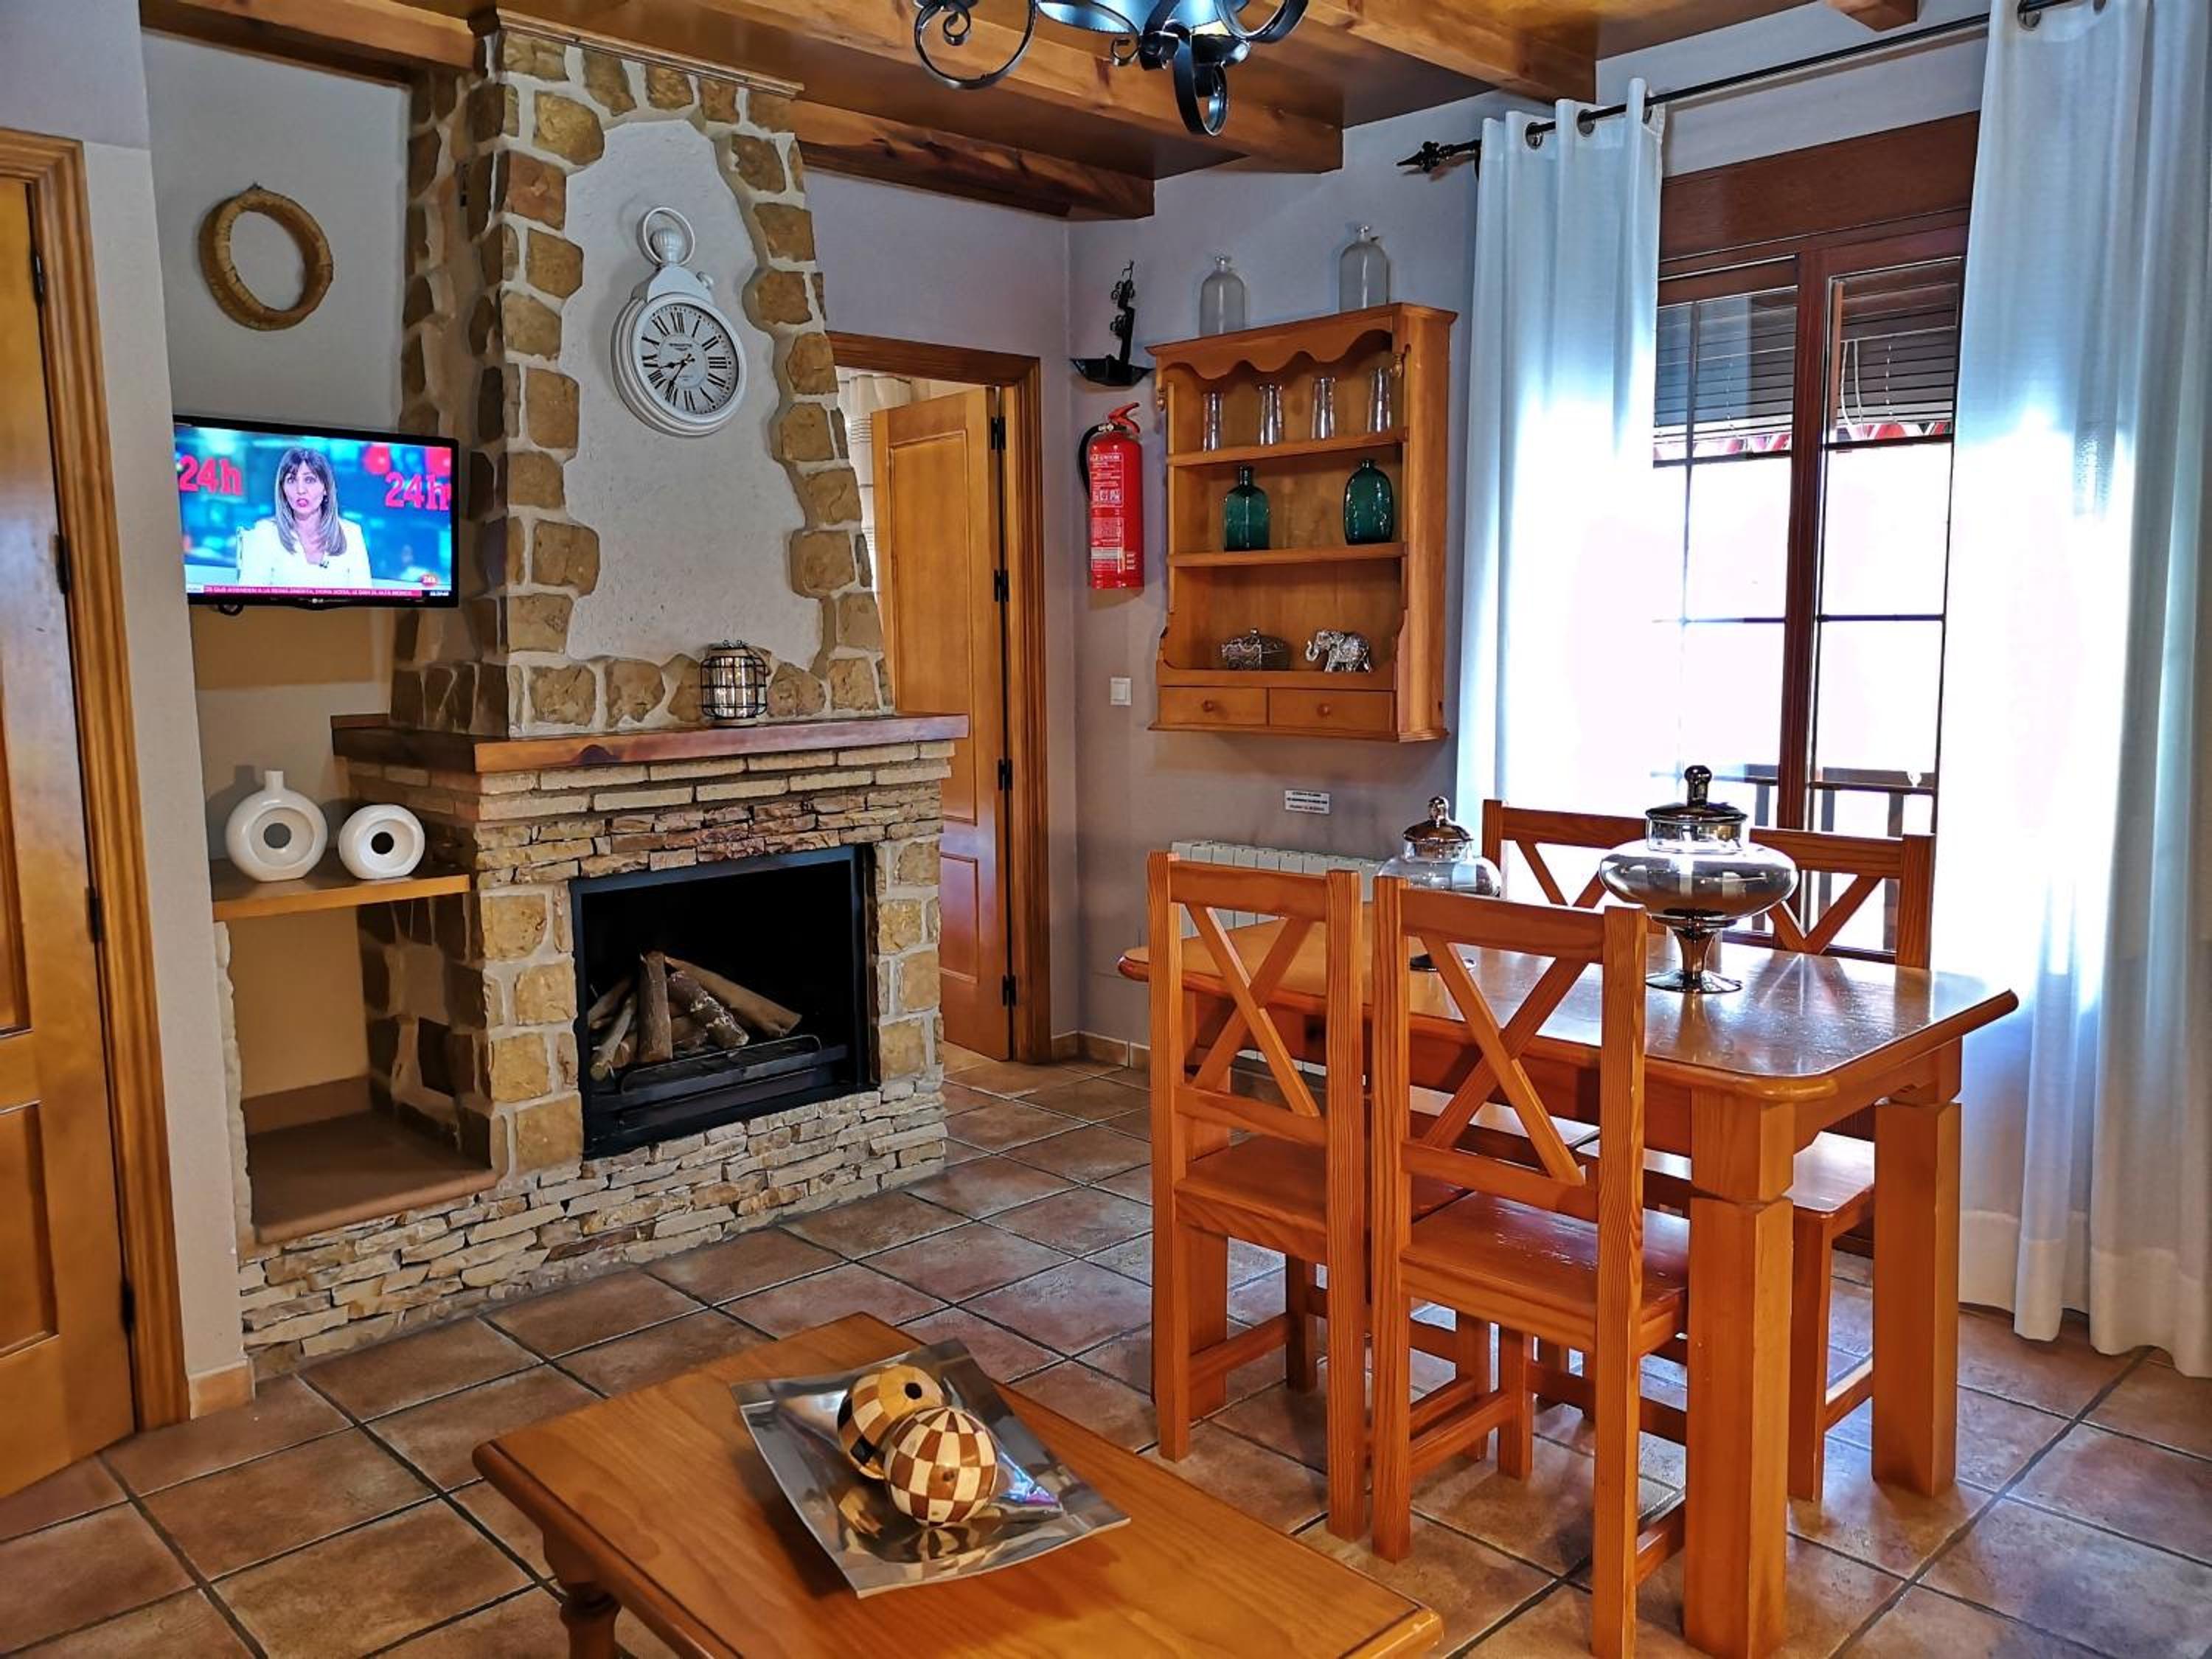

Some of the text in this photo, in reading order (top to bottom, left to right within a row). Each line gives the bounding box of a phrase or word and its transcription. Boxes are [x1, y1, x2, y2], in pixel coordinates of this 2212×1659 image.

[702, 336, 719, 351] II
[708, 356, 727, 369] III
[179, 455, 242, 495] 24h
[384, 471, 451, 511] 24h
